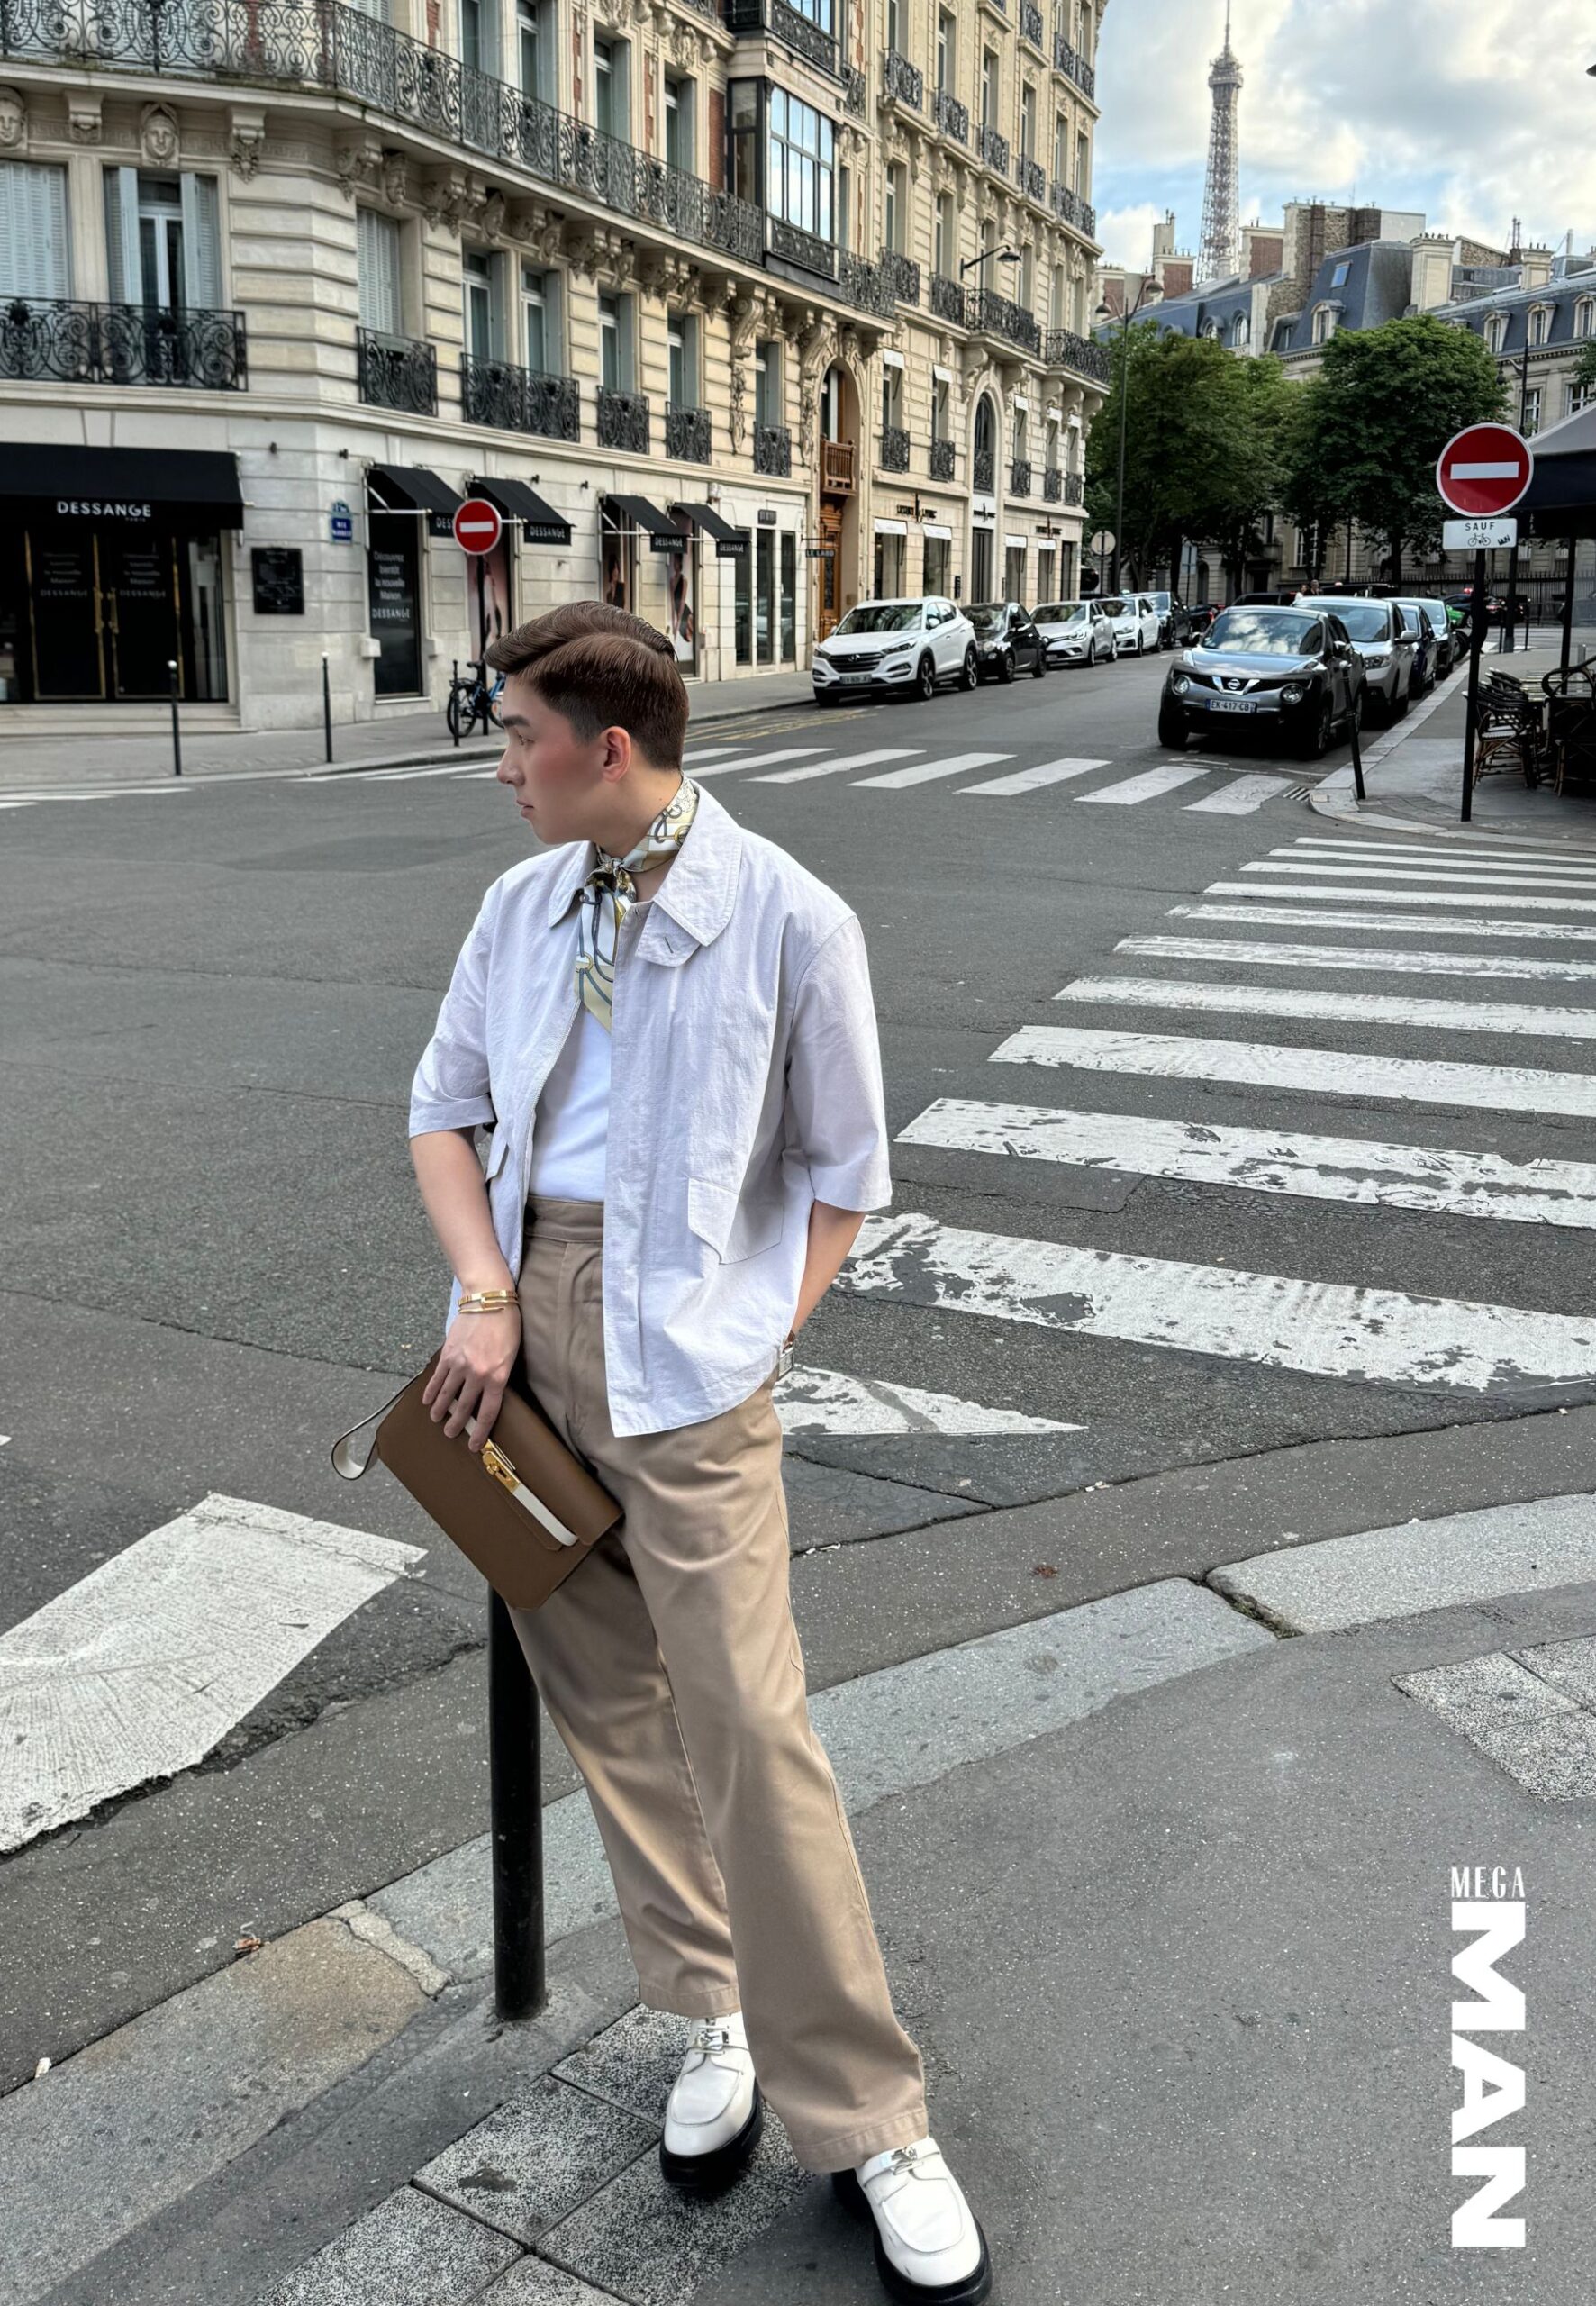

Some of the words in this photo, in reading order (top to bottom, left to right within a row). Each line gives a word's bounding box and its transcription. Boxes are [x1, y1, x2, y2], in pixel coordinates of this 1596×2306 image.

[56, 500, 152, 518] DESSANGE
[436, 517, 454, 530] DES
[1465, 522, 1495, 531] SAUF
[530, 525, 566, 539] DESSANGE
[654, 536, 683, 548] DESSANGE
[719, 542, 744, 553] DESSANGE
[371, 607, 411, 620] DESSANGE
